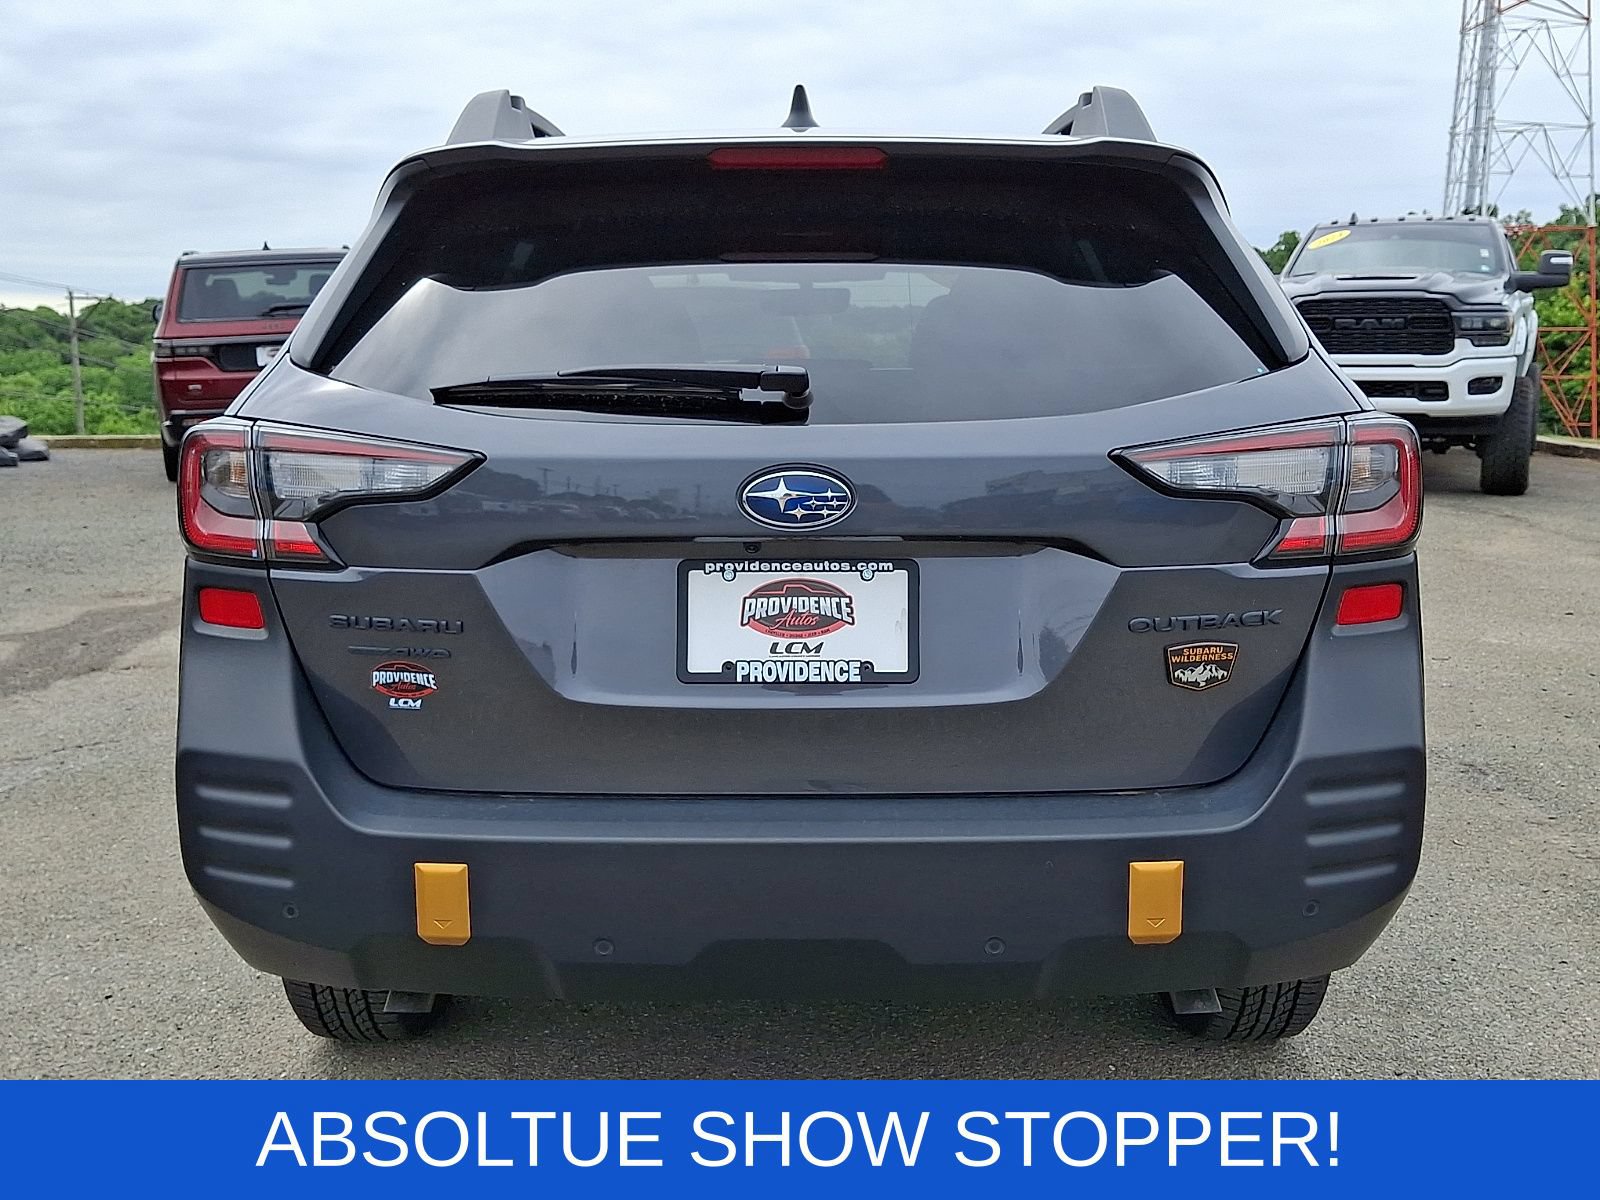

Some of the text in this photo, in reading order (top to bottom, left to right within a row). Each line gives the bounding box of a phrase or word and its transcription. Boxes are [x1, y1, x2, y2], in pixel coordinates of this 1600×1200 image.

[705, 560, 893, 572] providenceautos.com
[743, 597, 853, 625] PROVIDENCE
[770, 609, 819, 630] Autos
[328, 614, 464, 634] SUBARU
[1127, 609, 1283, 633] OUTBACK
[769, 641, 825, 655] LCM
[1171, 652, 1234, 663] WILDERNESS
[1183, 646, 1224, 656] SUBARU
[372, 671, 438, 690] PROVIDENCE
[736, 662, 861, 683] PROVIDENCE
[389, 697, 422, 708] LCM
